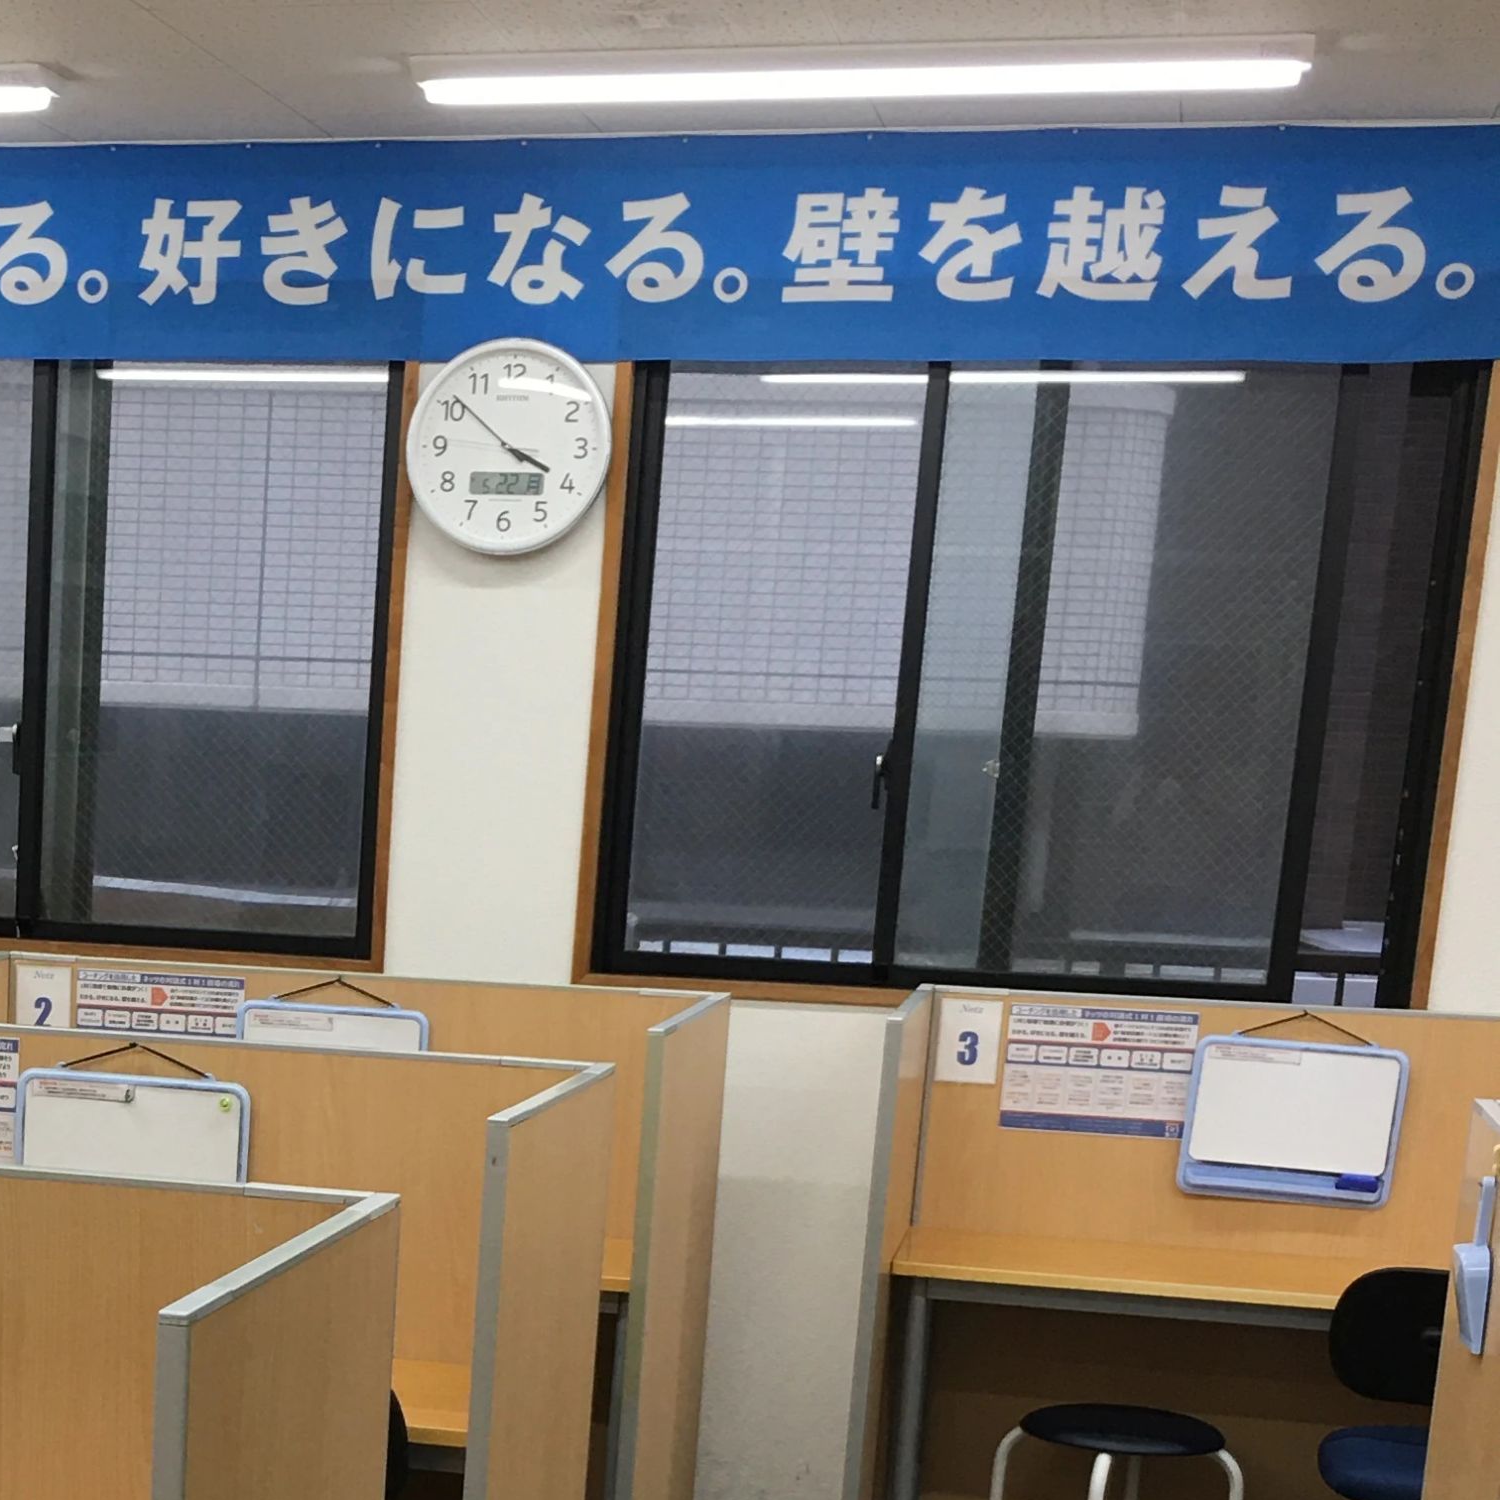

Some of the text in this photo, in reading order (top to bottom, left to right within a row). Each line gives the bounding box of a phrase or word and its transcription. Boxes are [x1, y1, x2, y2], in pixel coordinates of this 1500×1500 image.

[468, 373, 489, 394] 11
[441, 399, 465, 422] 10
[564, 401, 580, 423] 2
[432, 435, 447, 457] 9
[573, 437, 589, 459] 3
[440, 471, 455, 492] 8
[560, 472, 575, 494] 4
[464, 500, 478, 520] 7
[533, 501, 547, 522] 5
[496, 511, 511, 532] 6
[34, 997, 52, 1027] 2
[957, 1030, 979, 1065] 3
